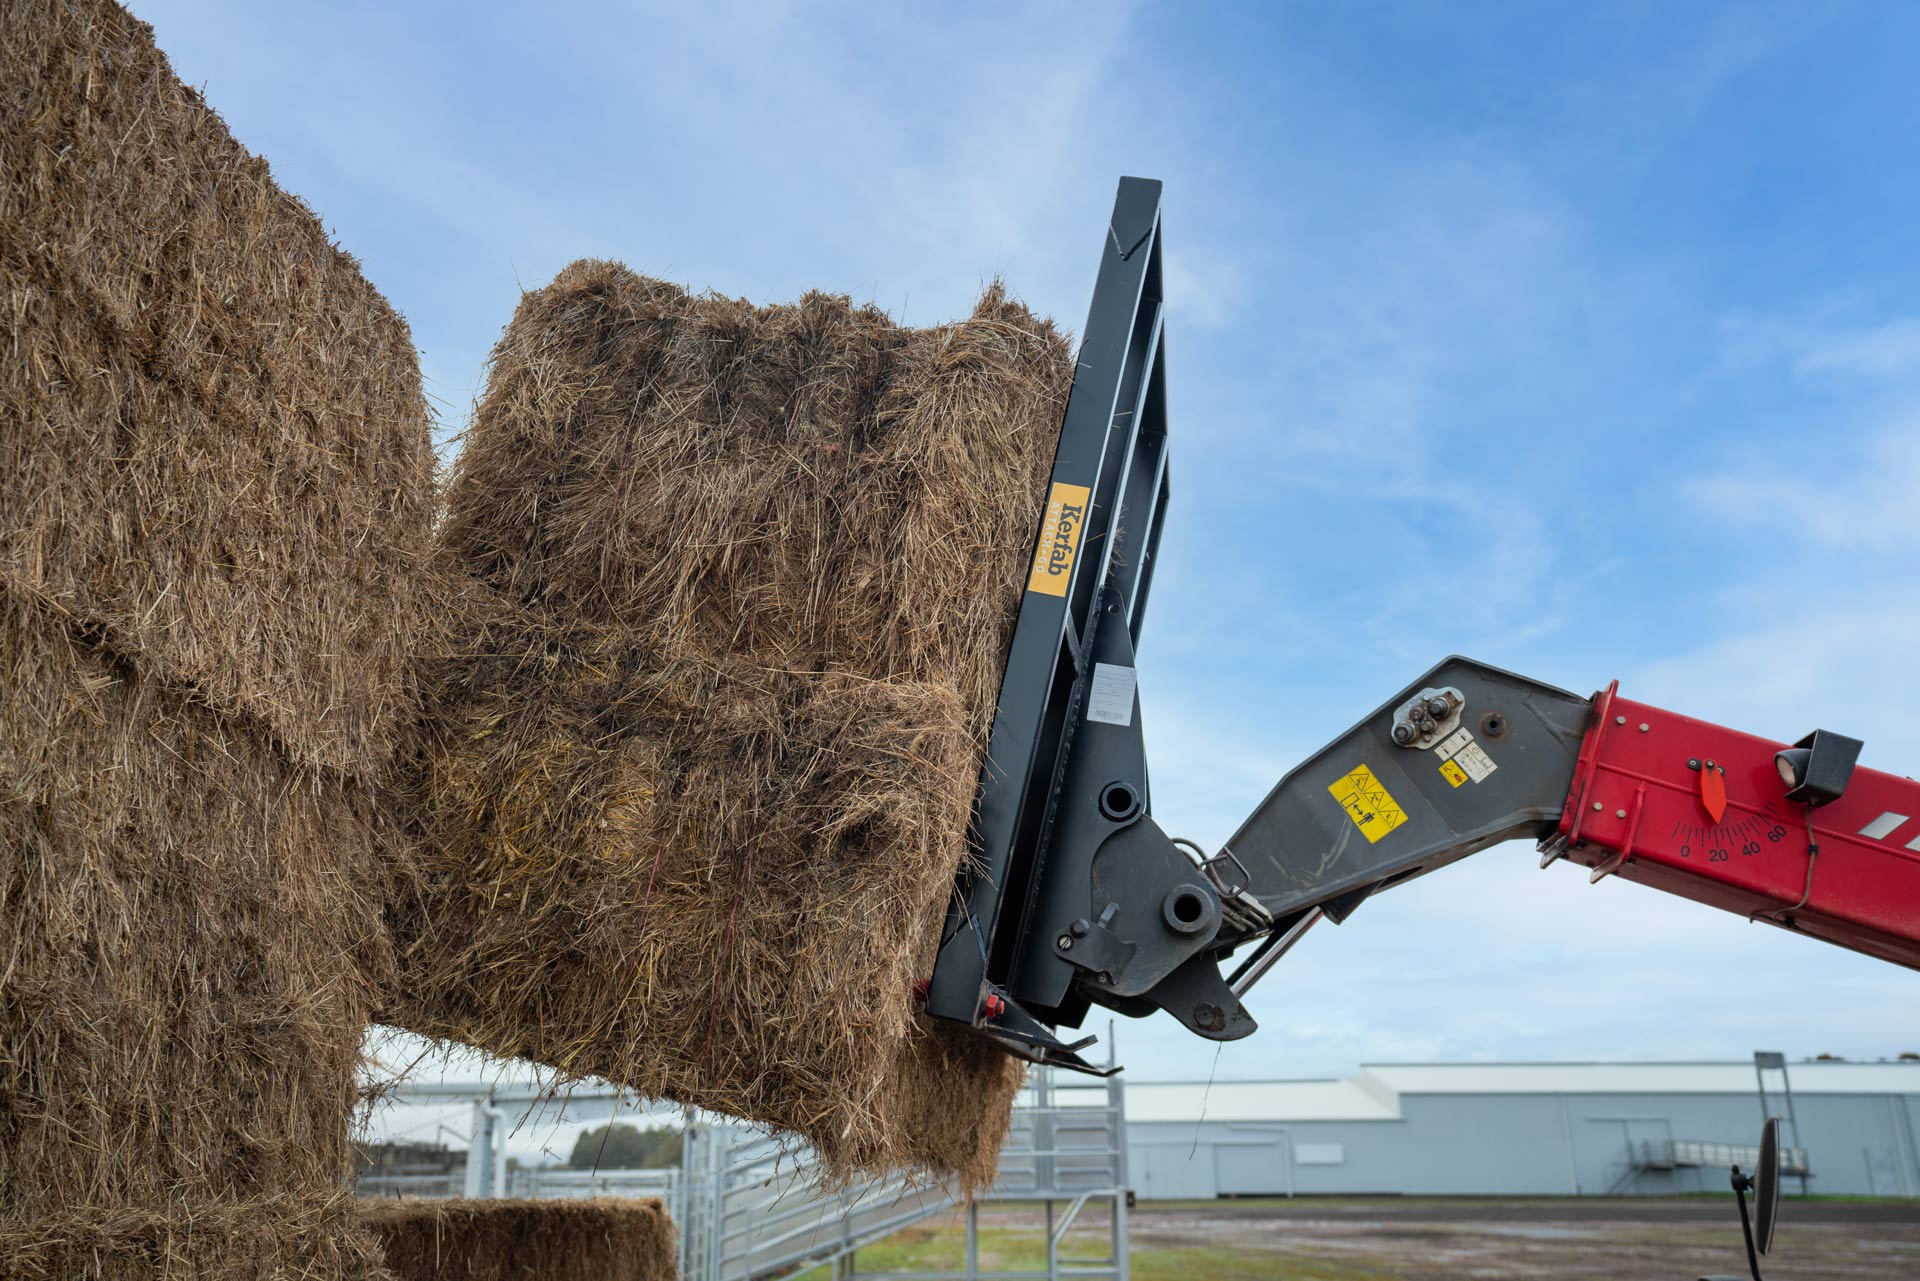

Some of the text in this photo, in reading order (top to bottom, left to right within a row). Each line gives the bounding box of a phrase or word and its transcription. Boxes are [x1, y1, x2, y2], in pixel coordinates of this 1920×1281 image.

[1048, 503, 1082, 576] Kerfab
[1680, 825, 1786, 861] 0 20 40 60
